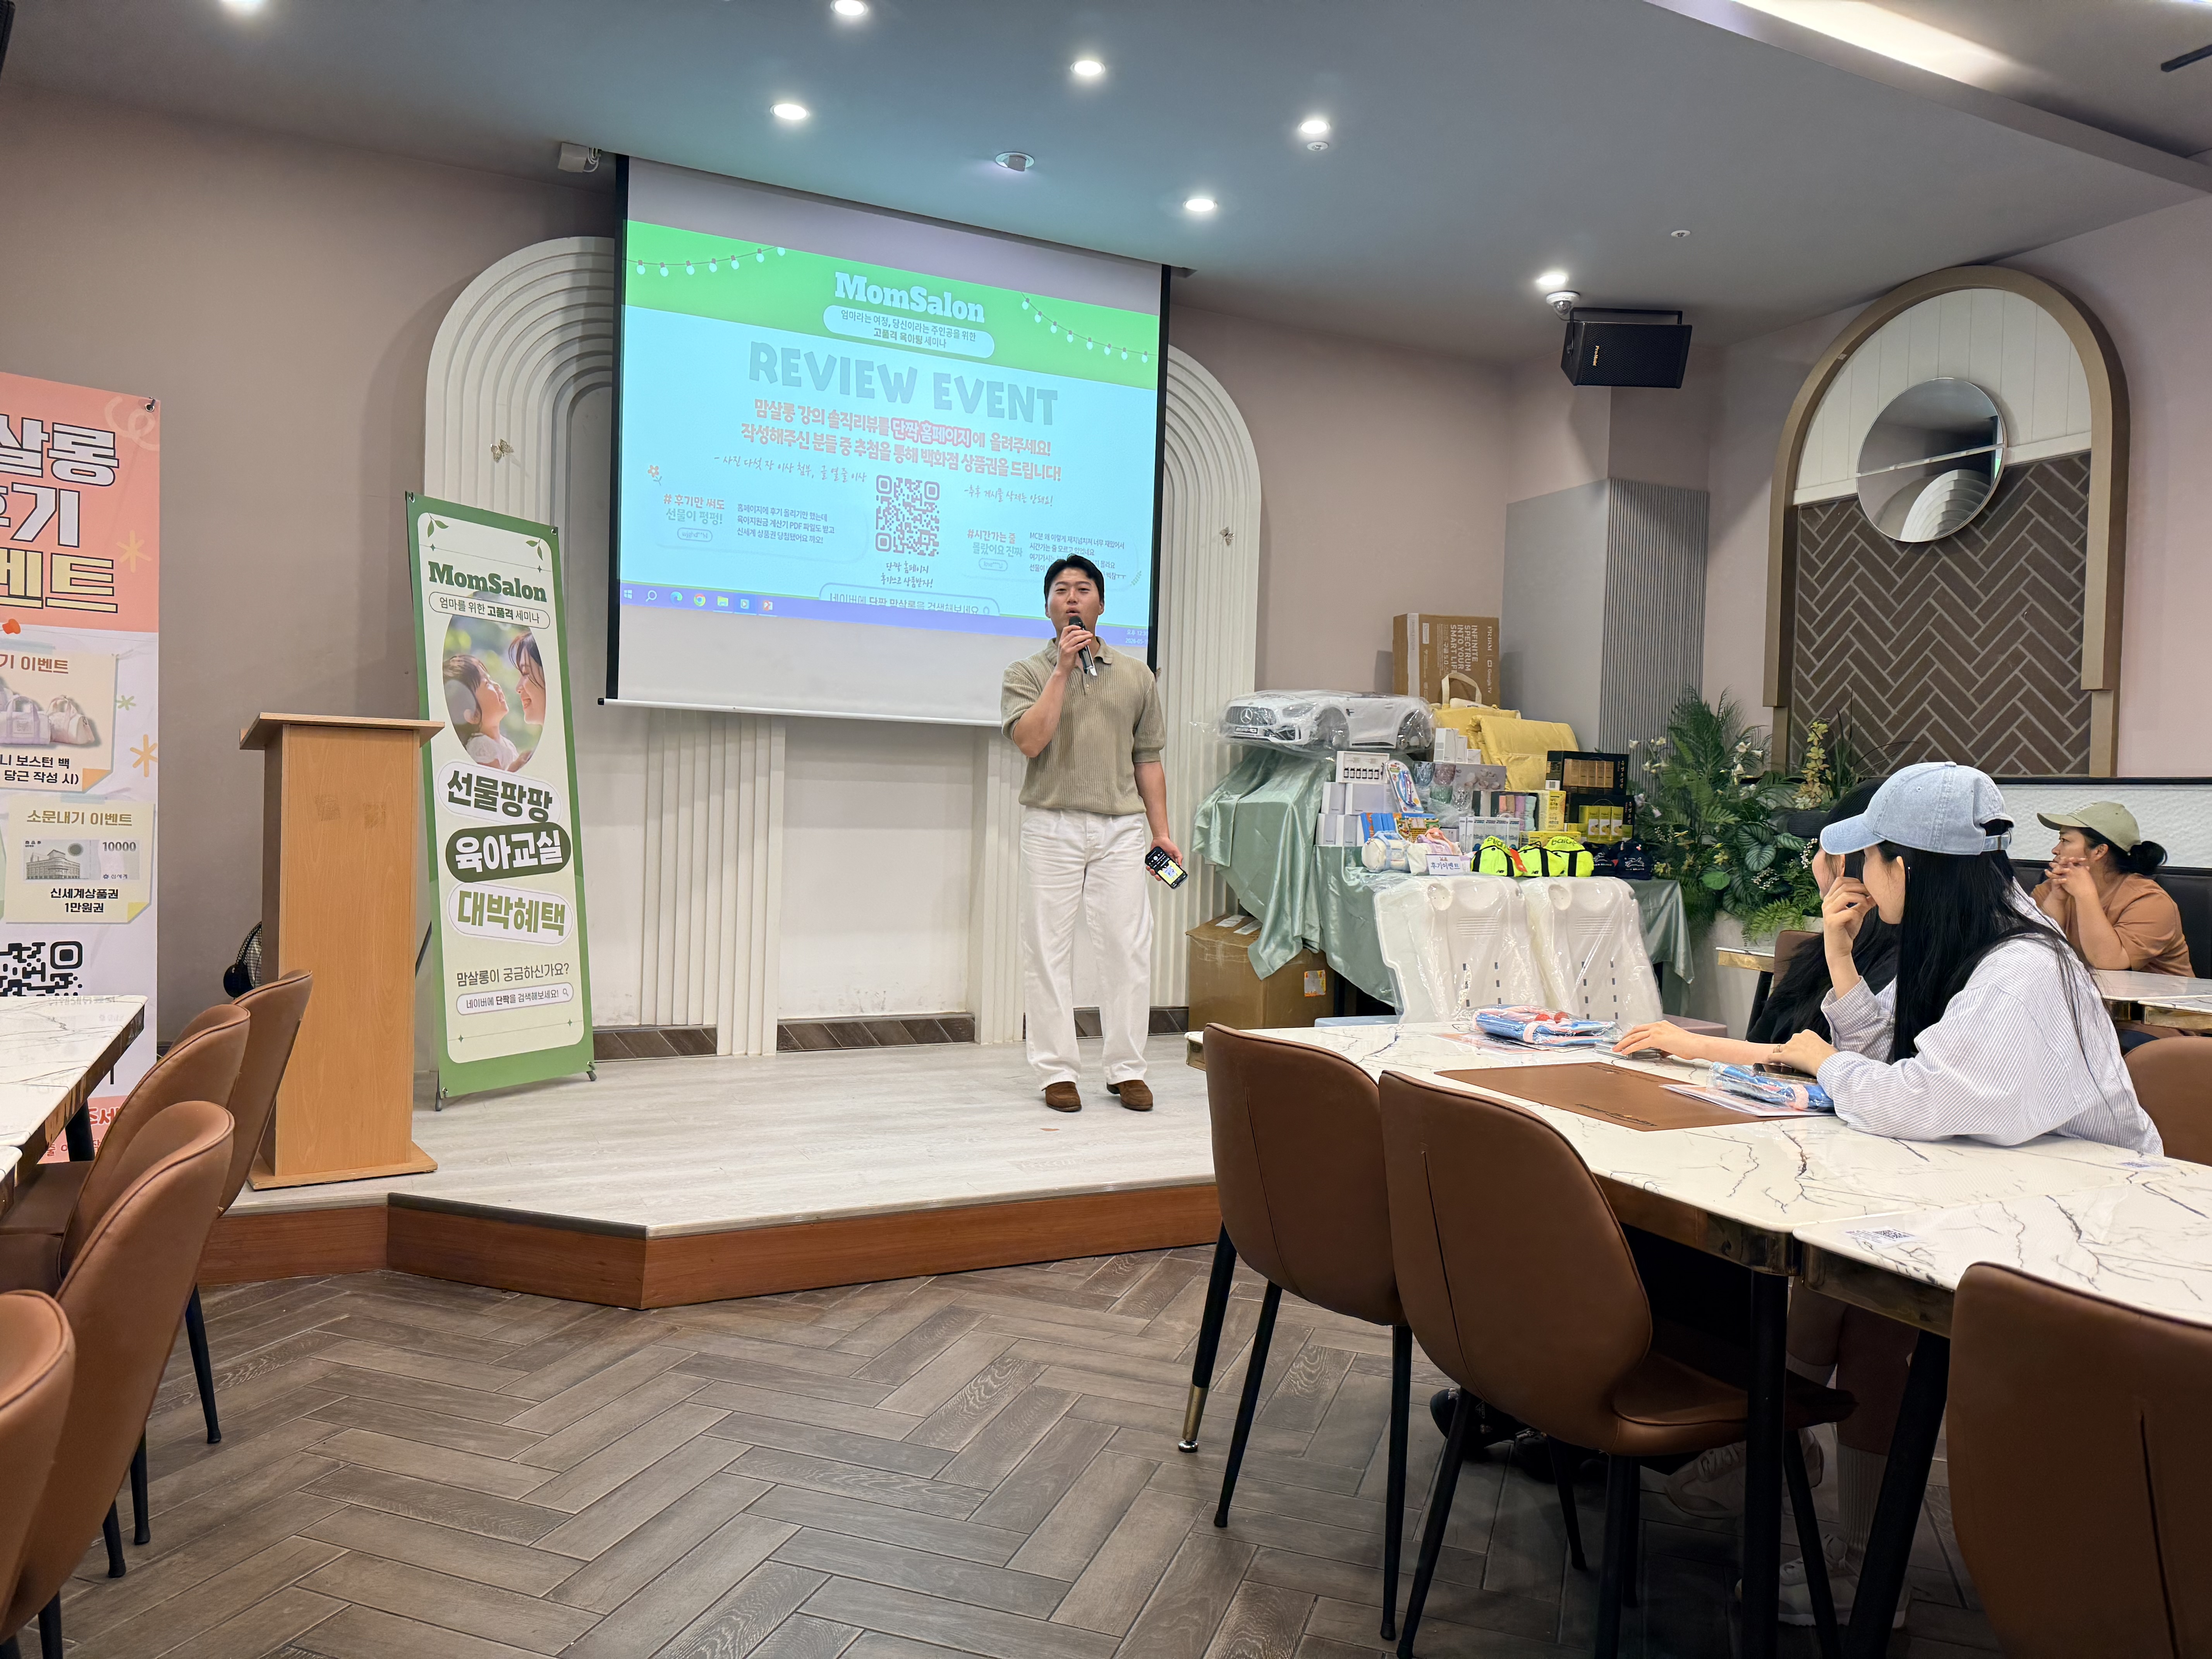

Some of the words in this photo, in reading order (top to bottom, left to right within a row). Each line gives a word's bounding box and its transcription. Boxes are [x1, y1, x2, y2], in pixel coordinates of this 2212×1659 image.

[835, 271, 985, 323] MomSalon
[841, 310, 871, 323] 엄마라는
[874, 316, 890, 328] 여정,
[893, 319, 929, 333] 당신이라는
[931, 326, 960, 339] 주인공을
[962, 331, 975, 342] 위한
[874, 328, 897, 340] 고품격
[925, 336, 946, 348] 세미나
[749, 341, 917, 403] REVIEW
[934, 373, 1058, 425] EVENT
[755, 399, 795, 422] 맘살롱
[798, 405, 825, 425] 강의
[828, 409, 890, 436] 솔직리뷰를
[892, 419, 918, 441] 단짝
[990, 432, 1051, 456] 올려주세요!
[741, 423, 809, 450] 작성해주신
[813, 433, 837, 453] 분들
[840, 437, 852, 456] 중
[854, 438, 891, 462] 추첨을
[894, 444, 919, 464] 통해
[921, 448, 958, 471] 백화점
[961, 453, 1008, 477] 상품권을
[1011, 461, 1061, 481] 드립니다!
[723, 456, 741, 467] 사진
[744, 457, 762, 471] 다섯
[765, 460, 774, 471] 장
[778, 462, 794, 473] 이상
[797, 462, 814, 478] 첨부,
[820, 465, 828, 480] 글
[831, 467, 839, 481] 열
[851, 472, 867, 482] 이상
[675, 494, 704, 508] 후기만
[706, 498, 725, 510] 써도
[984, 488, 1003, 502] 게시물
[1006, 491, 1027, 503] 삭제는
[0, 485, 80, 548] 기
[666, 508, 696, 522] 선물이
[699, 511, 723, 525] 펑펑!
[770, 508, 782, 516] 후기
[737, 515, 768, 527] 육아지원금
[790, 522, 802, 530] PDF
[803, 523, 821, 532] 파일도
[823, 525, 835, 534] 받고
[737, 527, 756, 537] 신세계
[757, 529, 776, 539] 상품권
[1009, 533, 1015, 544] 줄
[1030, 543, 1051, 551] 시간가는
[1006, 546, 1022, 557] 진짜
[904, 561, 929, 574] 홈페이지
[428, 561, 547, 603] MomSalon
[440, 597, 465, 611] 엄마를
[468, 602, 485, 615] 위한
[487, 605, 514, 620] 고품격
[516, 611, 539, 624] 세미나
[21, 656, 69, 674] 이벤트
[16, 756, 53, 768] 보스턴
[58, 758, 70, 769] 백
[4, 770, 29, 782] 당근
[33, 771, 58, 784] 작성
[62, 774, 79, 785] 시)
[447, 770, 553, 823] 선물팡팡
[27, 810, 84, 825] 소문내기
[90, 813, 132, 826] 이벤트
[102, 842, 136, 852] 10000
[455, 830, 563, 873] 육아교실
[50, 888, 118, 899] 신세계상품권
[65, 903, 104, 913] 1만원권
[458, 890, 565, 936] 대박혜택
[457, 969, 500, 987] 맘살롱이
[503, 963, 569, 982] 궁금하신가요?
[466, 997, 494, 1008] 네이버에
[496, 994, 516, 1005] 단짝을
[518, 989, 559, 1003] 검색해보세요!
